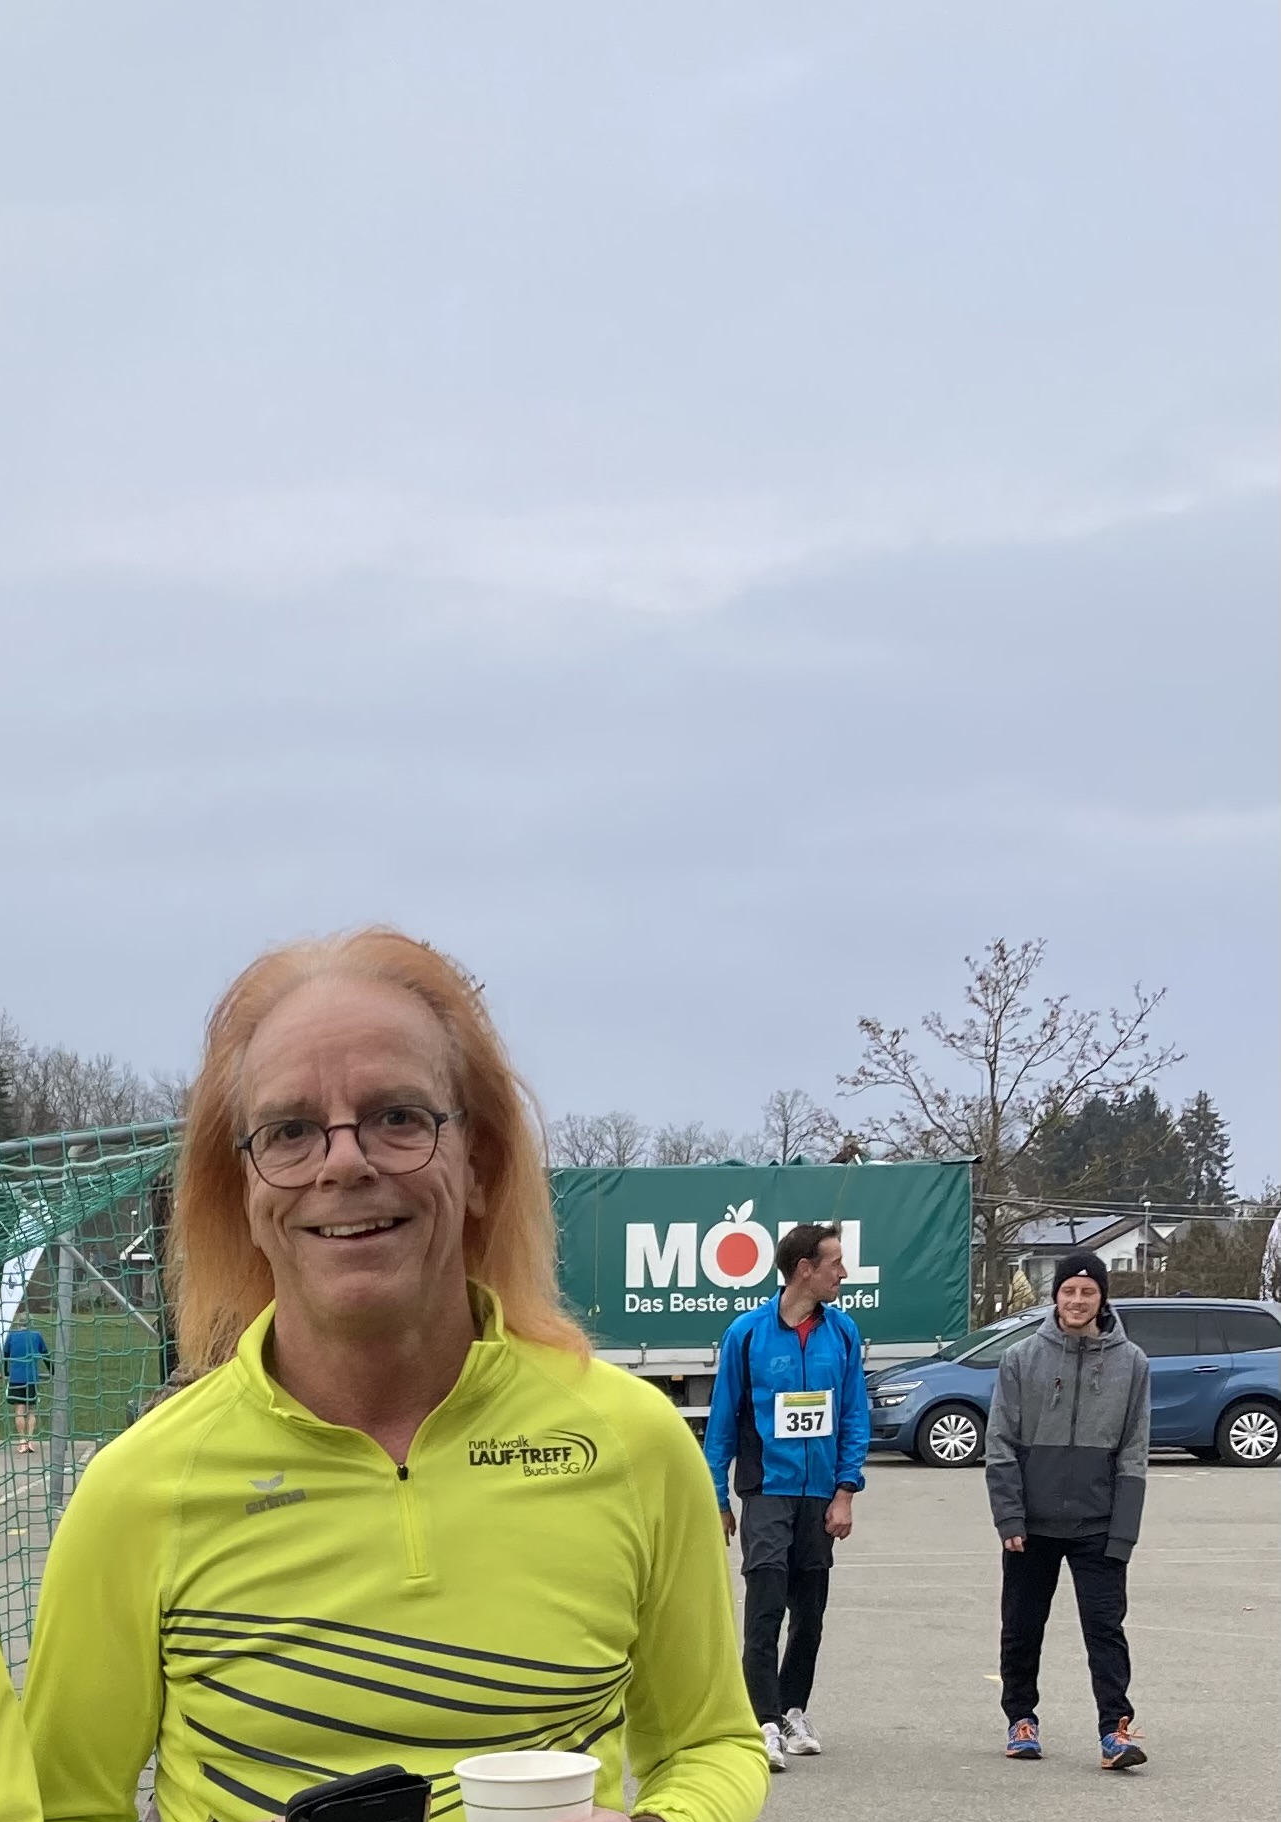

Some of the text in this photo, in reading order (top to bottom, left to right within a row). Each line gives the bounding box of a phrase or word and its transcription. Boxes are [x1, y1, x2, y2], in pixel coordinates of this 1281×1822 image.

[625, 1294, 663, 1313] Das
[670, 1293, 727, 1312] Beste
[734, 1295, 769, 1311] aus
[786, 1411, 825, 1432] 357
[469, 1435, 529, 1449] run & walk
[469, 1447, 572, 1465] LAUF-TREFF
[523, 1461, 580, 1477] Buchs SG
